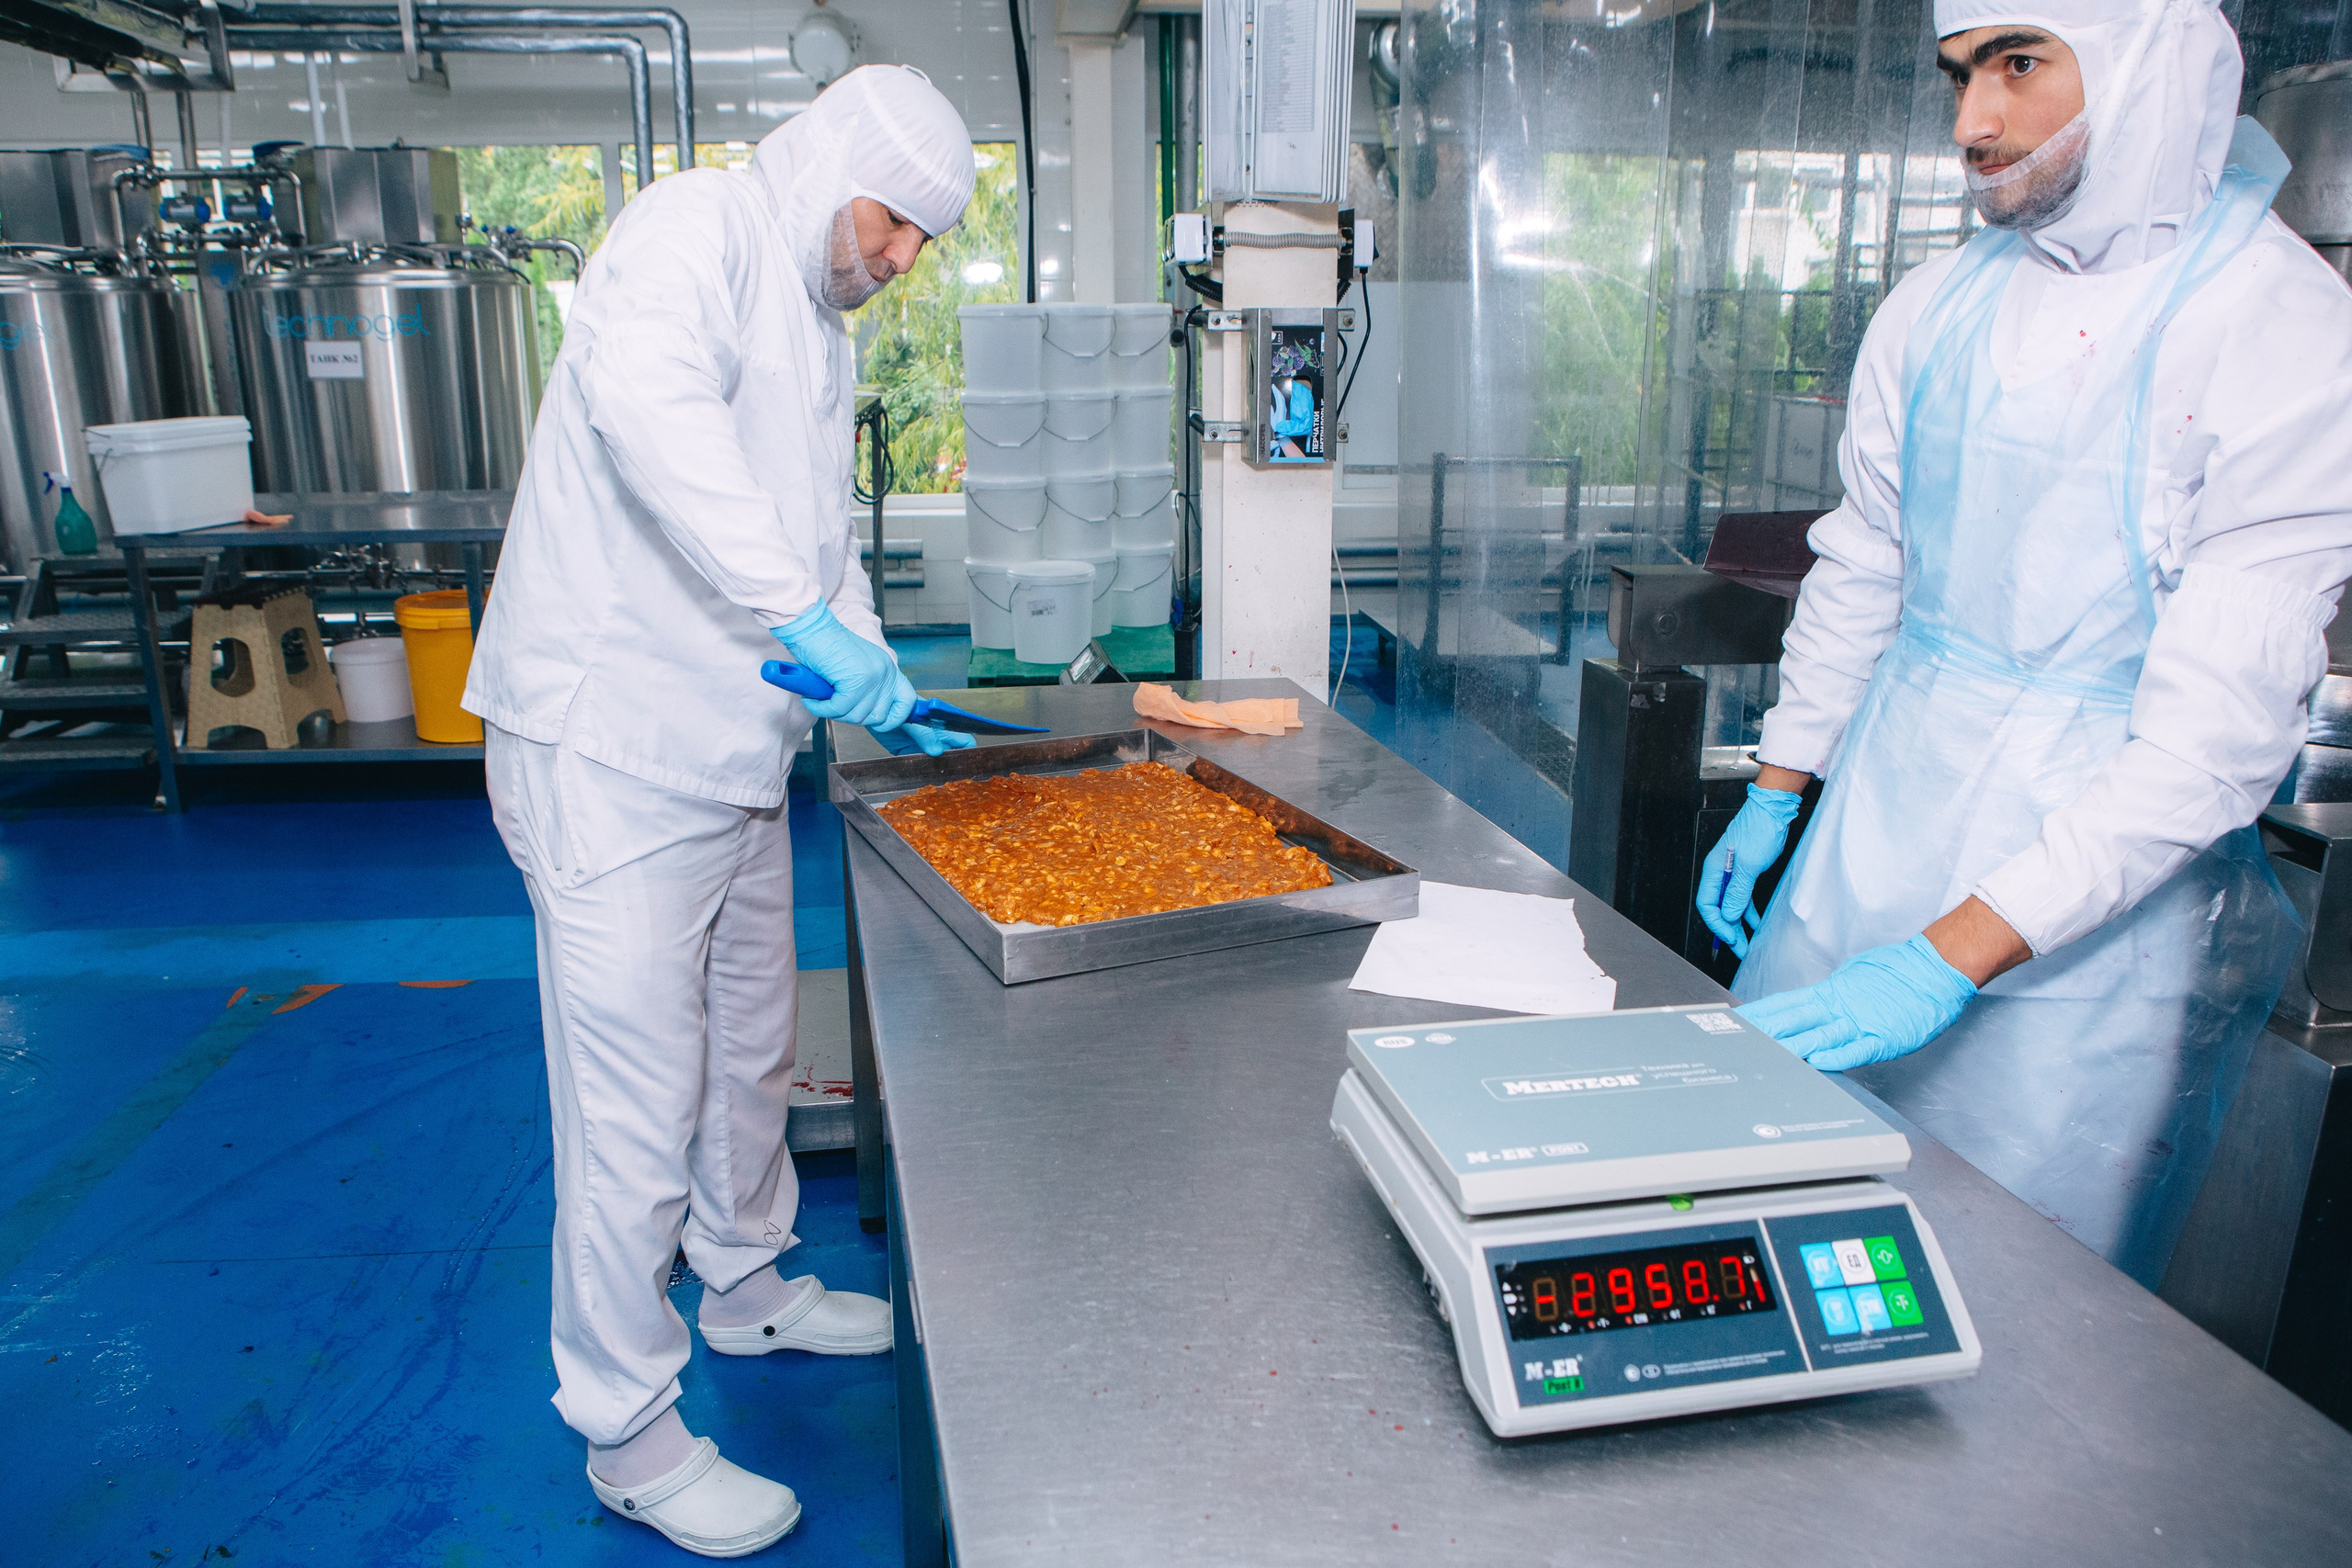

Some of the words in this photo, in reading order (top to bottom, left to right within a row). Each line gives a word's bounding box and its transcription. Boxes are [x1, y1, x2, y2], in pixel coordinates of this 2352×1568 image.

[1312, 411, 1320, 453] ПЕРЧАТКИ
[1502, 1074, 1640, 1096] MERTECH
[1846, 1253, 1861, 1269] ЕД
